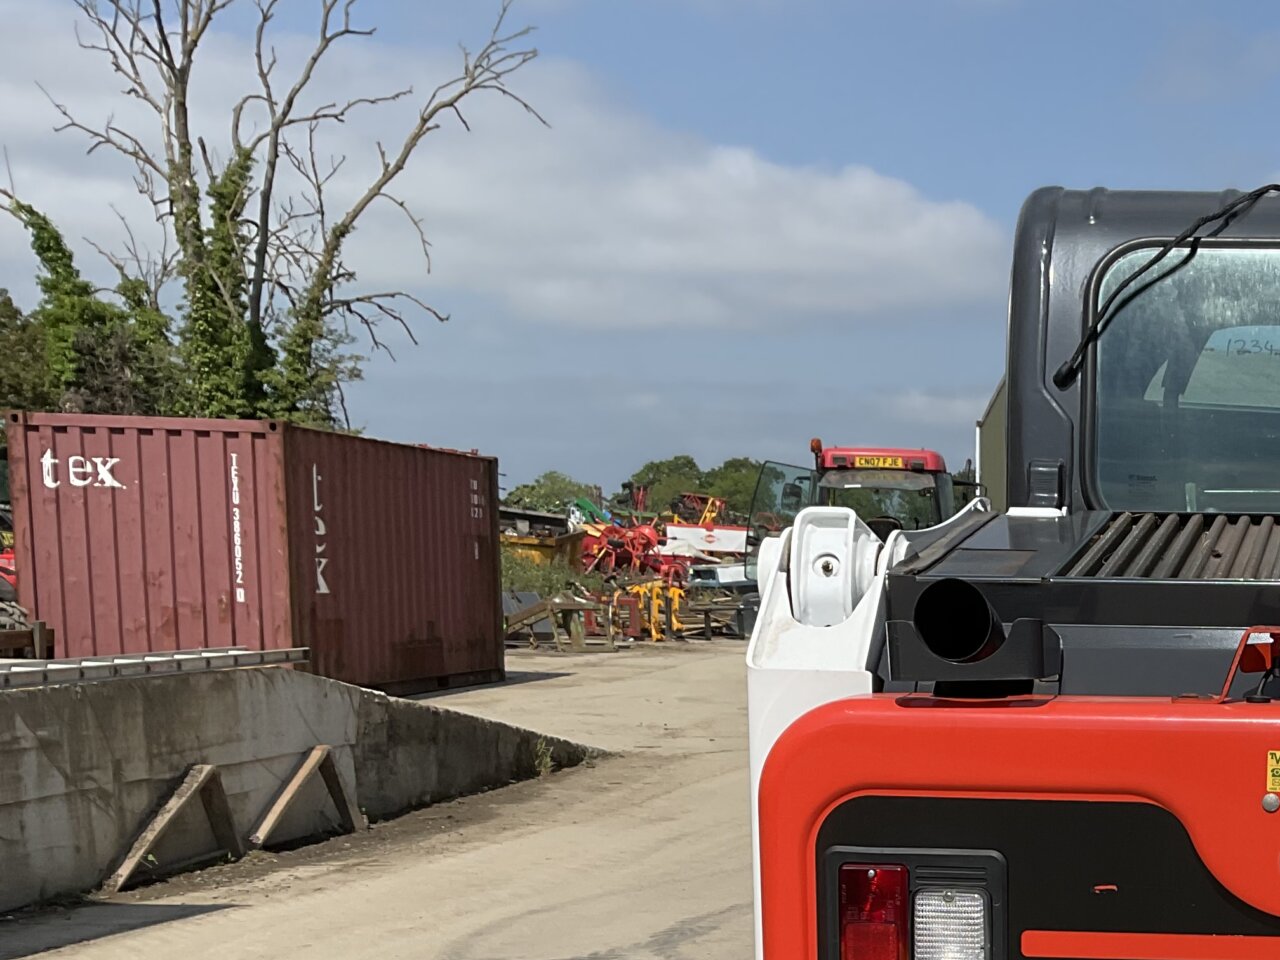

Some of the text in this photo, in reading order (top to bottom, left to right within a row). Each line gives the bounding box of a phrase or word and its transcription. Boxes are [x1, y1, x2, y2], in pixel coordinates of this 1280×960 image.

[40, 448, 124, 488] tex
[230, 453, 240, 504] TEXU
[859, 458, 900, 467] CN07 FJE
[232, 507, 243, 584] 386052
